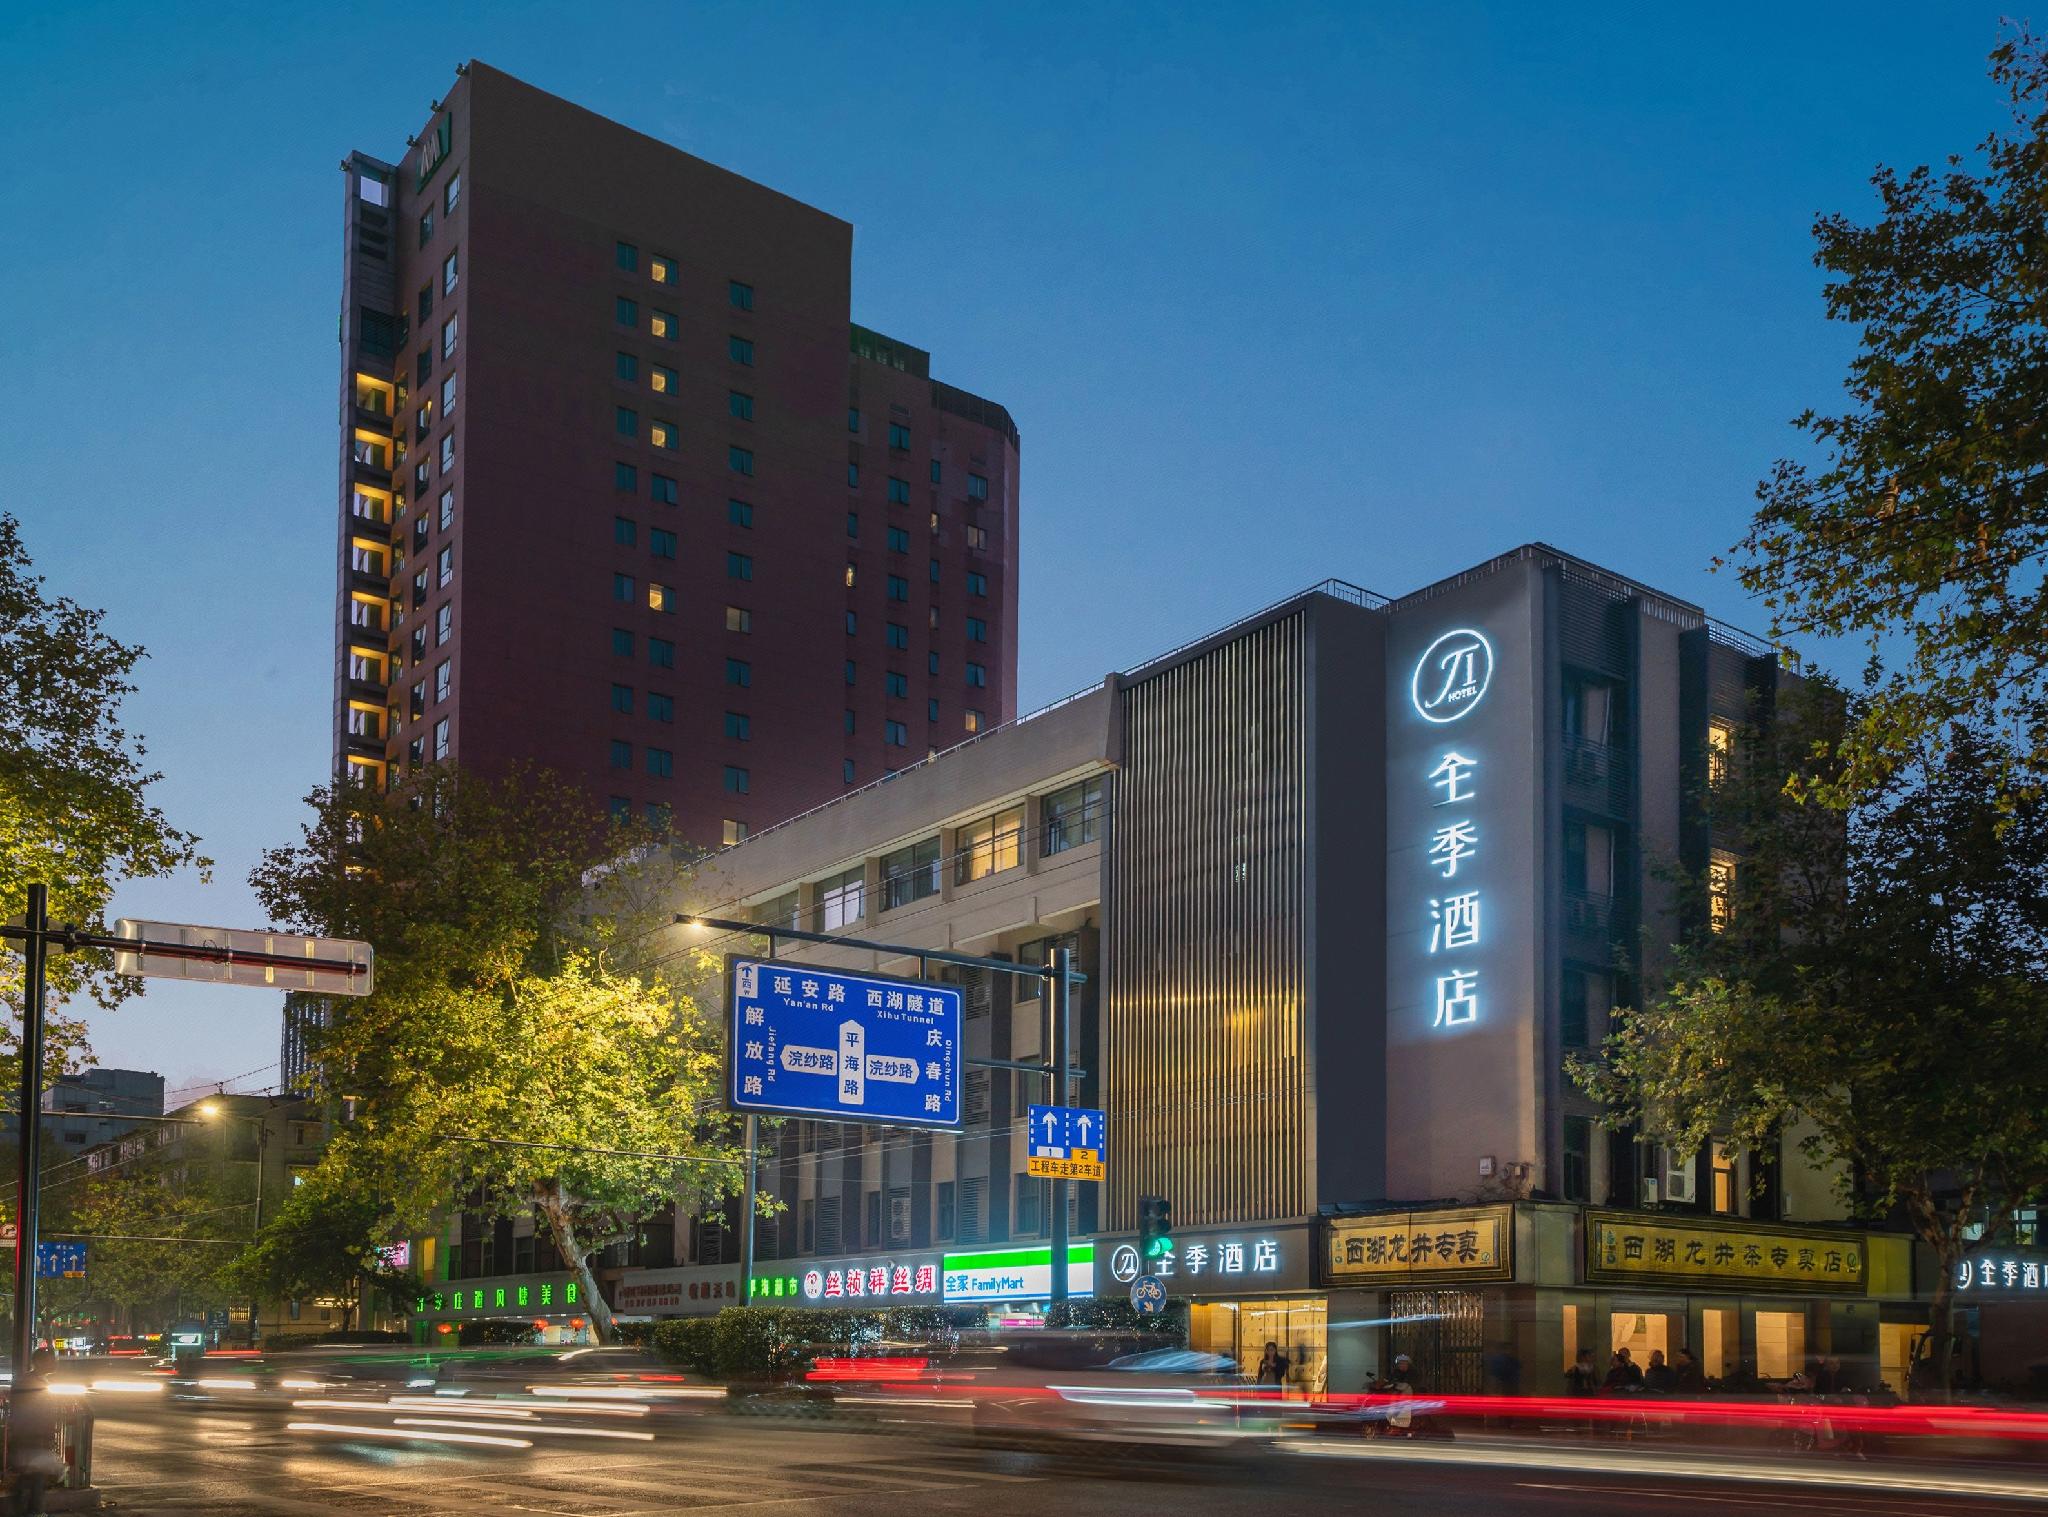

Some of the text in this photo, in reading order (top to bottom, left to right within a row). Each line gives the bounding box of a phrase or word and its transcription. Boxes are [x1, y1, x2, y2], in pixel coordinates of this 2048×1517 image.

[1448, 686, 1478, 703] HOTEL
[1429, 751, 1479, 1028] 全季酒店
[741, 977, 752, 989] 西
[773, 976, 846, 1003] 延安路
[783, 998, 834, 1012] Yan'an Rd
[866, 989, 945, 1016] 西湖隧道
[877, 1010, 934, 1024] Xihu Tunnel
[743, 1005, 765, 1096] 解放路
[767, 1026, 777, 1082] Jiefang Rd
[788, 1050, 834, 1071] 浣纱路
[844, 1032, 860, 1096] 平海路
[869, 1059, 914, 1079] 浣纱路
[924, 1029, 943, 1112] 庆春路
[943, 1040, 952, 1102] Qingchun Rd
[1031, 1160, 1101, 1177] 工程车走第2车道
[1080, 1151, 1088, 1160] 2
[1154, 1239, 1278, 1276] 全季酒店
[1345, 1229, 1479, 1265] 西湖龙井专卖
[1623, 1235, 1842, 1272] 西湖龙井茶专卖店
[824, 1265, 934, 1297] 丝祯祥丝绸
[945, 1274, 968, 1292] 全家
[971, 1275, 1024, 1294] FamilyMart
